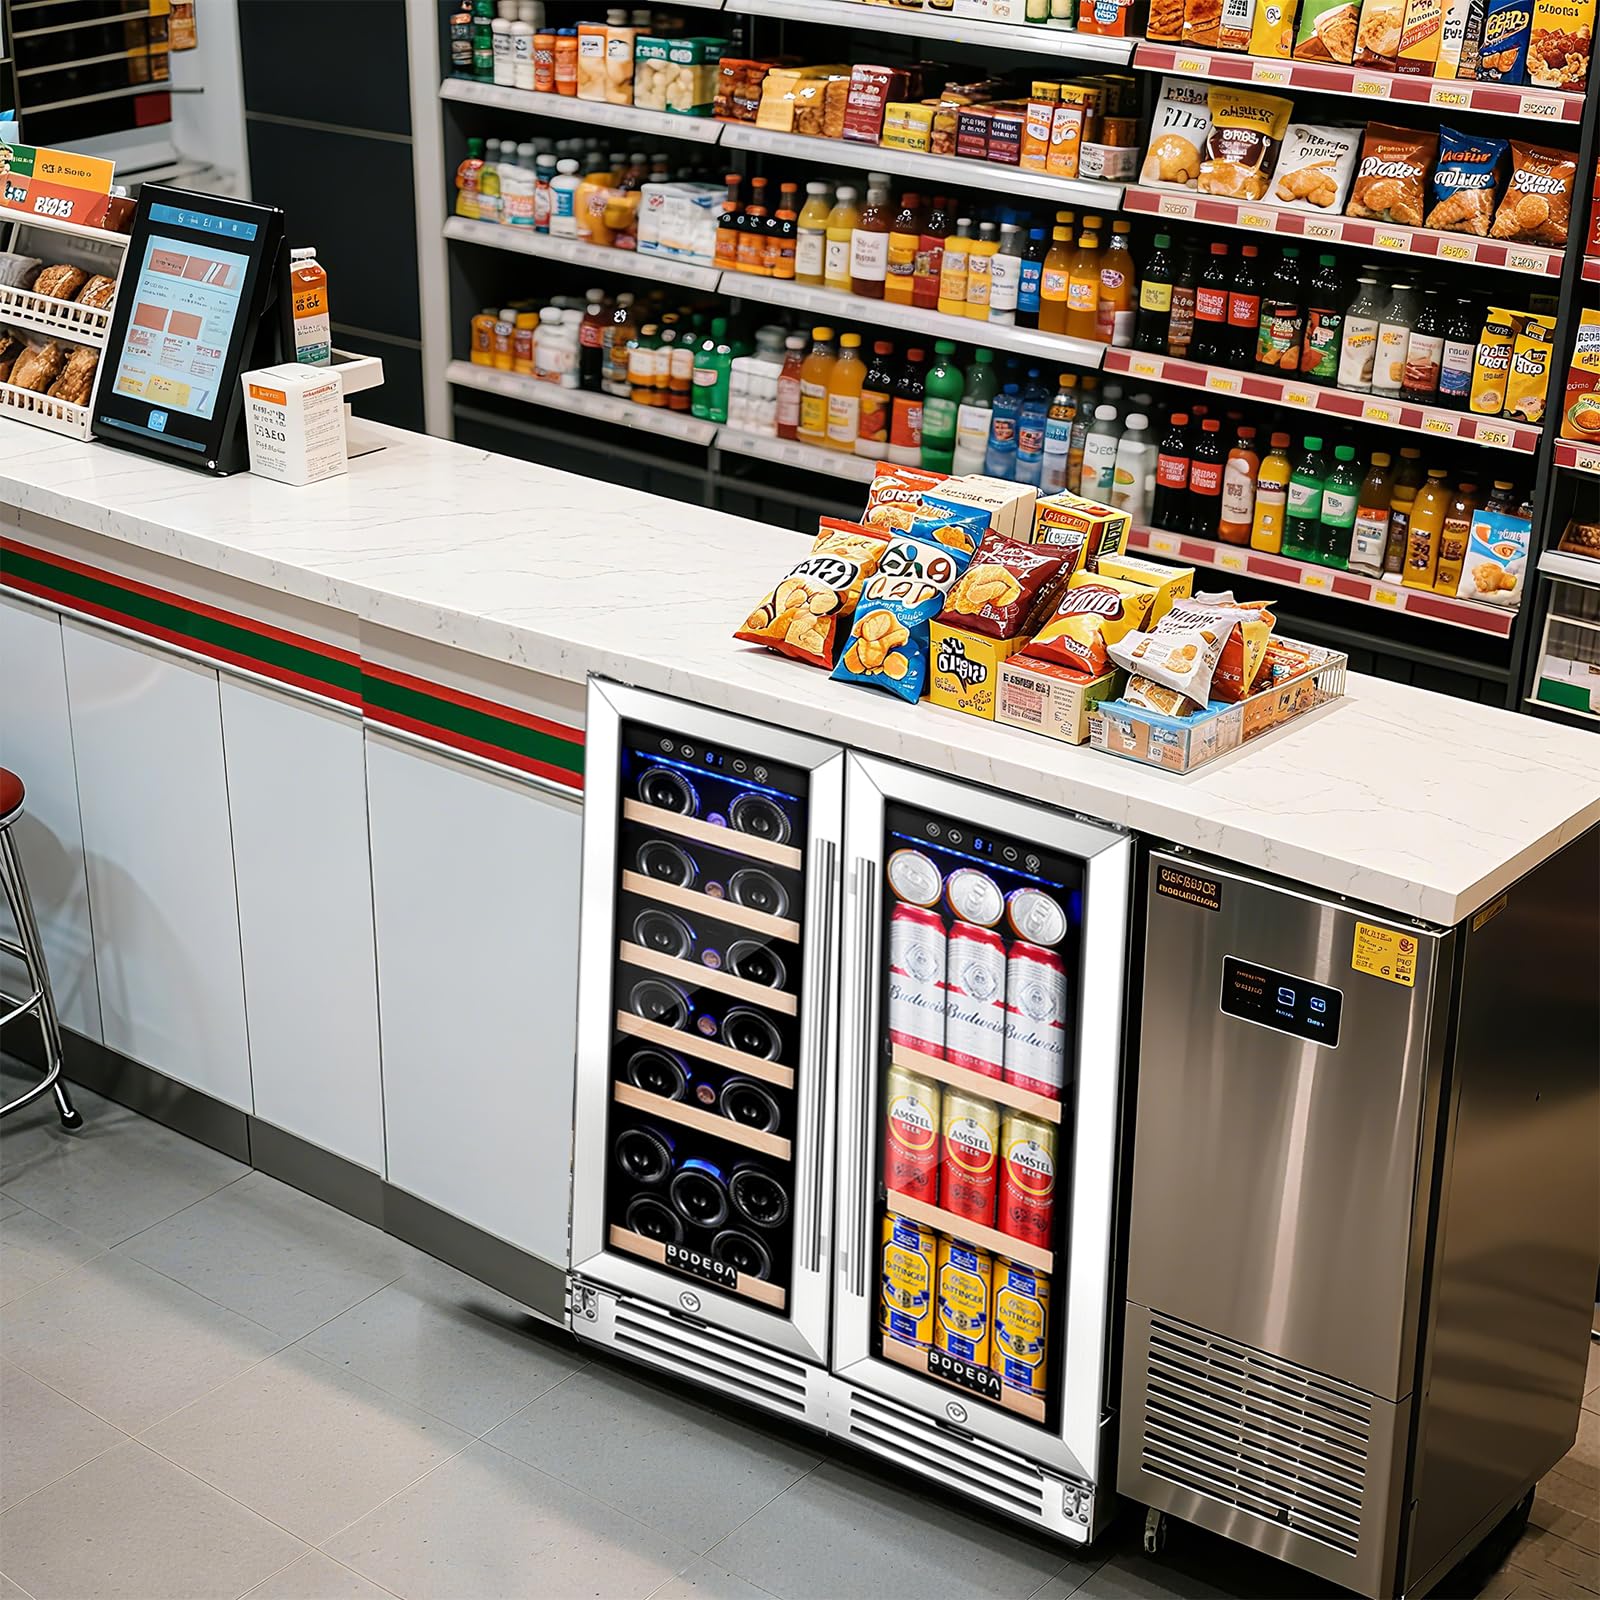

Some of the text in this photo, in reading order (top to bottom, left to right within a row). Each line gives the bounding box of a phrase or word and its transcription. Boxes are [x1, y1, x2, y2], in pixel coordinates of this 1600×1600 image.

[893, 1108, 931, 1129] AMSTEL
[901, 1122, 921, 1136] BEER
[951, 1129, 990, 1151] AMSTEL
[959, 1145, 981, 1158] BEER
[1012, 1152, 1052, 1174] AMSTEL
[1021, 1168, 1042, 1180] BEER
[667, 1244, 736, 1279] BODEGA
[929, 1351, 1000, 1391] BODEGA
